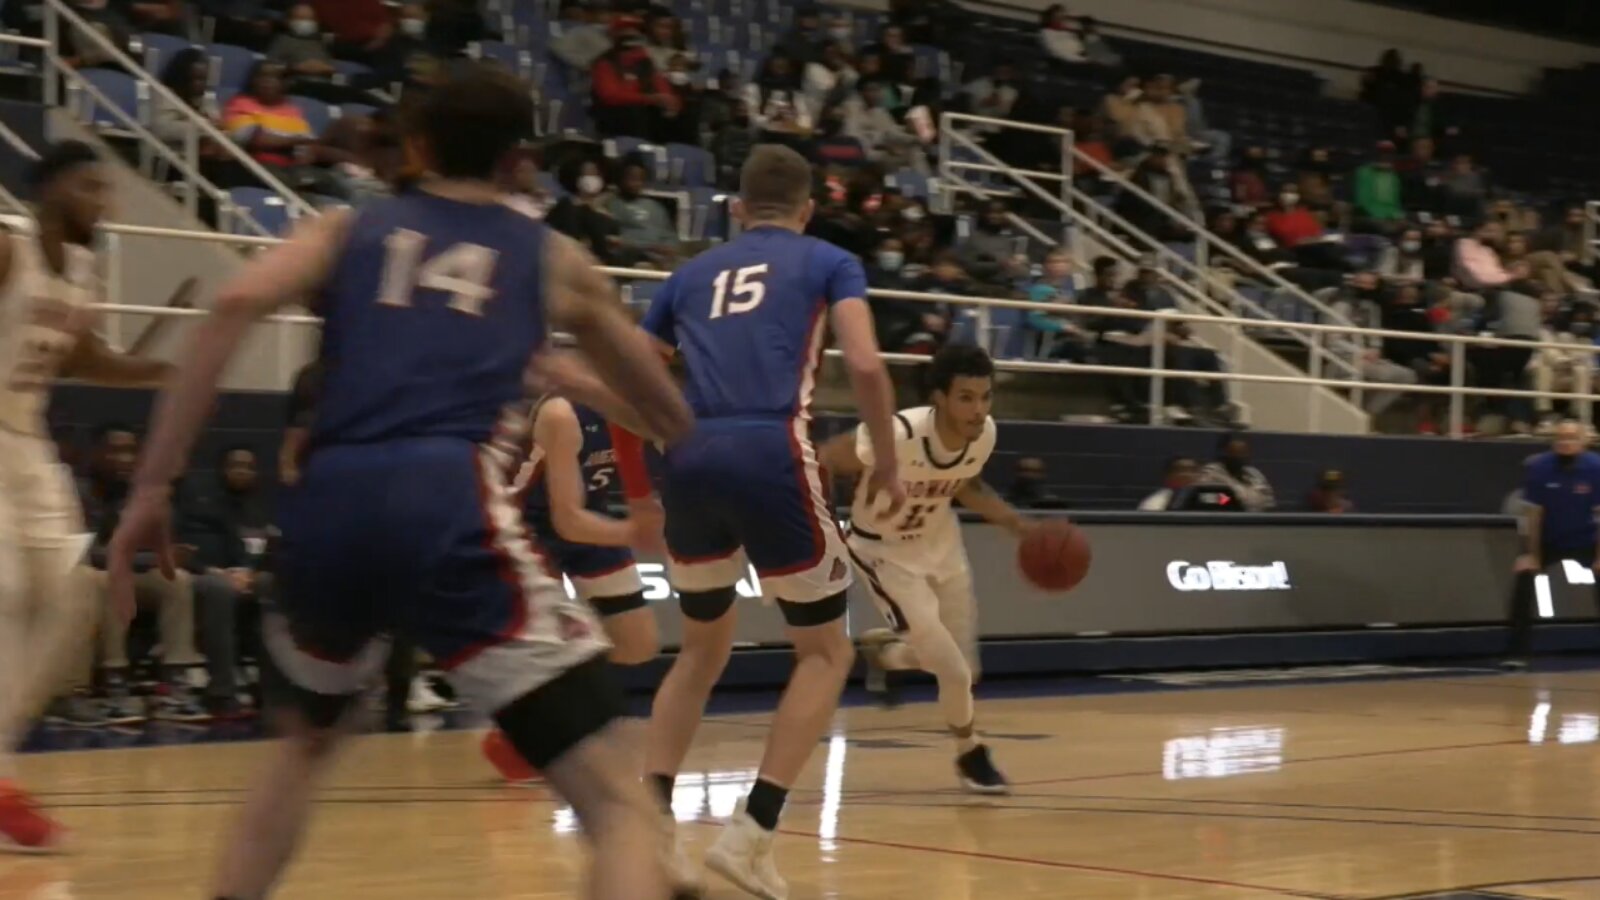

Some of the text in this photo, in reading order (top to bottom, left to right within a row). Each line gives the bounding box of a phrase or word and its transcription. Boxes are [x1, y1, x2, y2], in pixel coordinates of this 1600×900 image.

[376, 226, 500, 317] 14
[709, 263, 768, 319] 15
[588, 467, 615, 492] 5
[1166, 560, 1212, 591] Go
